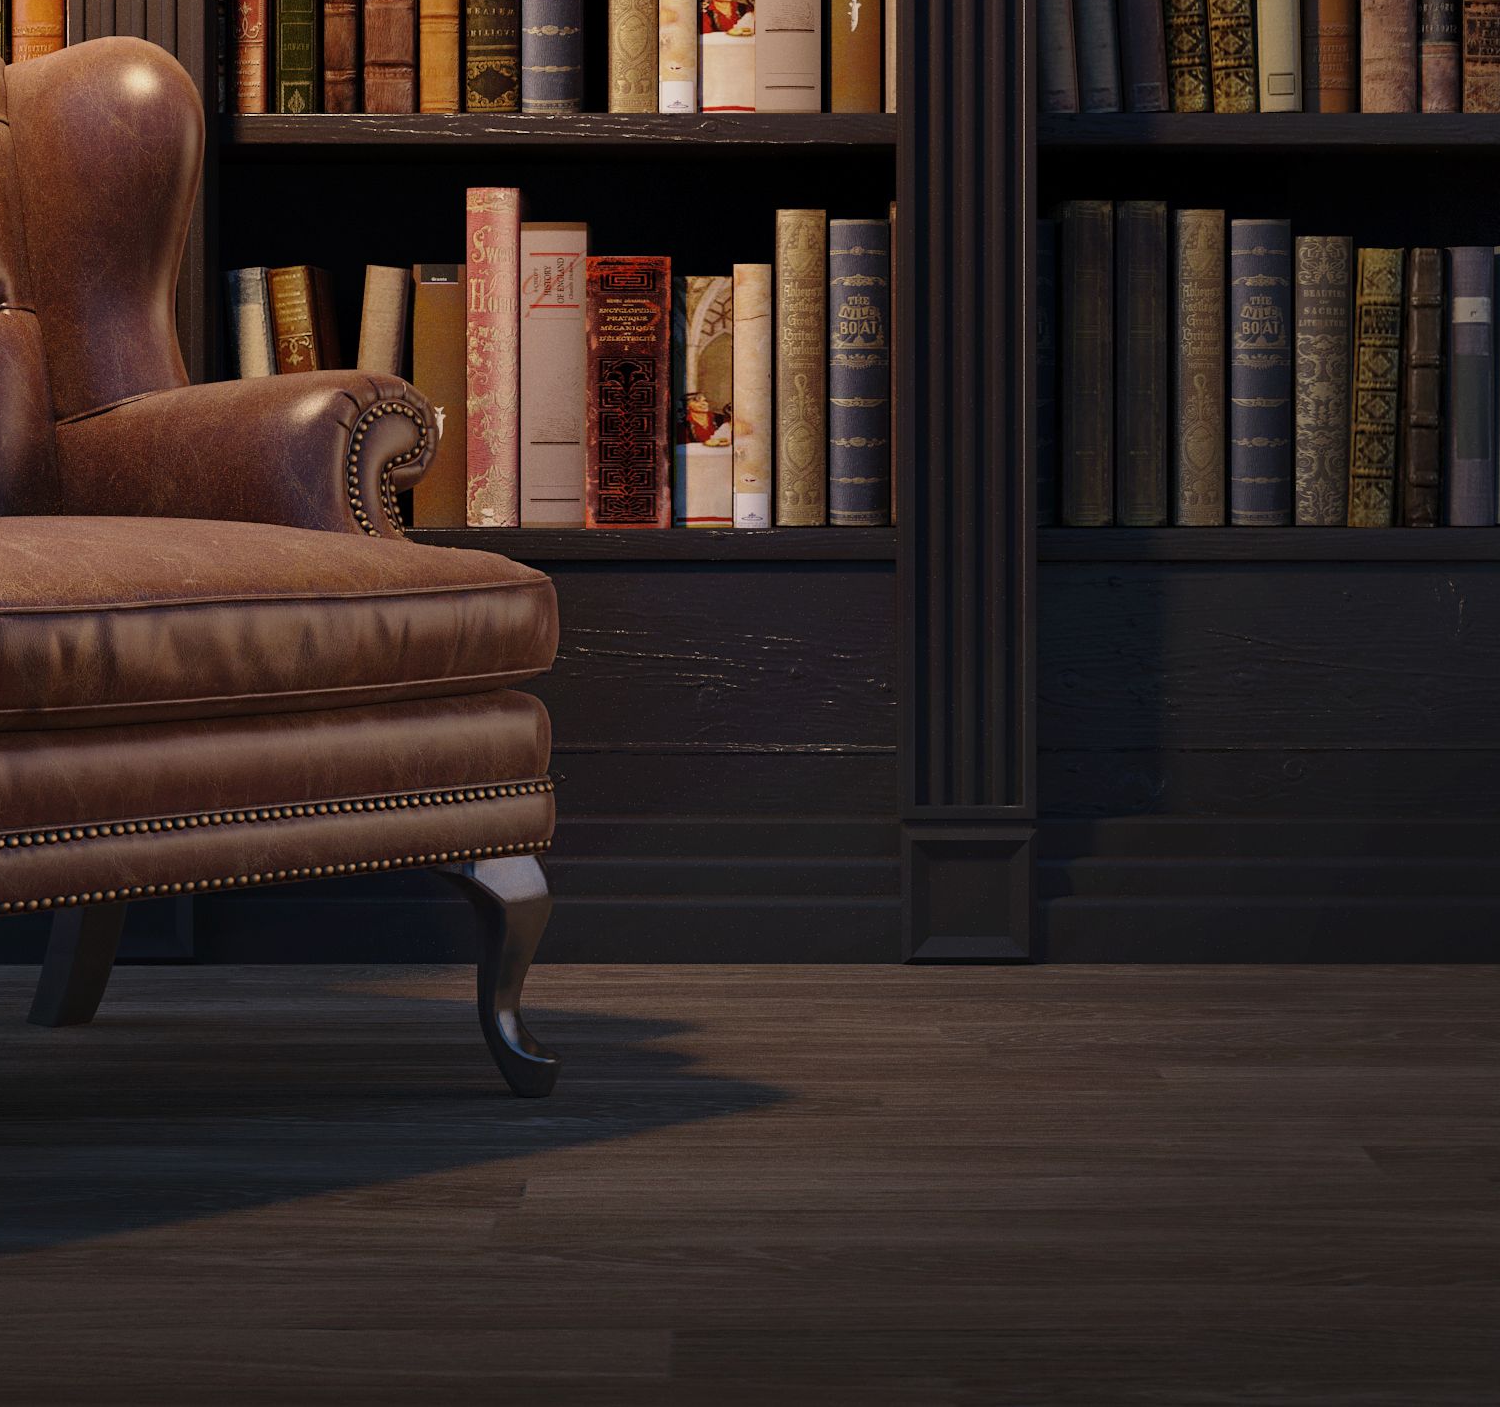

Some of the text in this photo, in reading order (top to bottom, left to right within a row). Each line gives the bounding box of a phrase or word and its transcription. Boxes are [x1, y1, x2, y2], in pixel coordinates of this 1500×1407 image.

[543, 265, 551, 296] HISTORY
[556, 257, 564, 304] OF ENGLAND
[1304, 289, 1347, 298] BEAUTIES
[847, 296, 871, 305] THE
[1249, 296, 1273, 305] THE
[840, 305, 877, 318] NILE
[1242, 305, 1279, 318] NILE
[1303, 307, 1346, 316] SACRED
[839, 320, 878, 334] BOAT
[1241, 320, 1280, 334] BOAT
[784, 327, 820, 341] Britain
